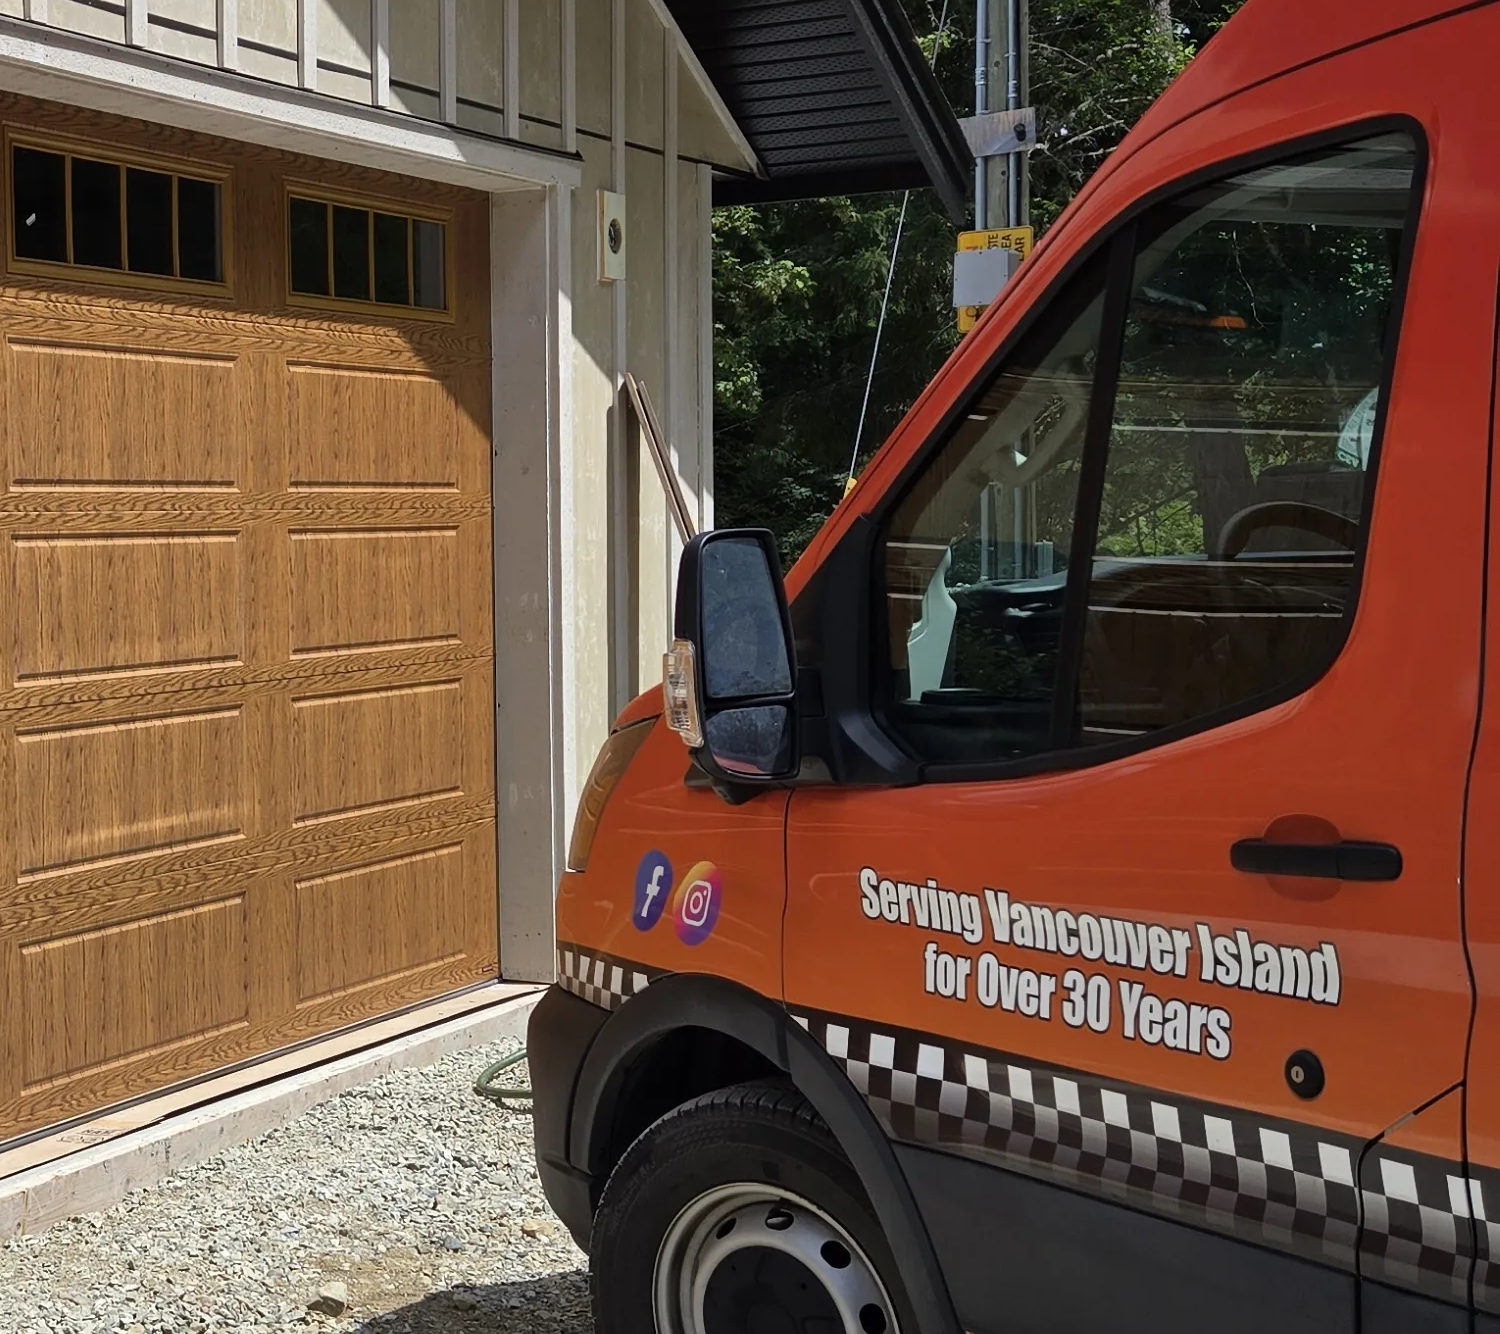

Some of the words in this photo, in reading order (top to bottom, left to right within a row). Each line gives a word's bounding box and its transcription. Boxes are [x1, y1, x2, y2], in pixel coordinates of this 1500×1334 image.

[859, 866, 984, 945] Serving
[983, 887, 1192, 978] Vancouver
[1195, 921, 1342, 1006] Island
[923, 940, 972, 1001] for
[977, 951, 1057, 1021] Over
[1061, 968, 1111, 1034] 30
[1118, 978, 1232, 1061] Years
